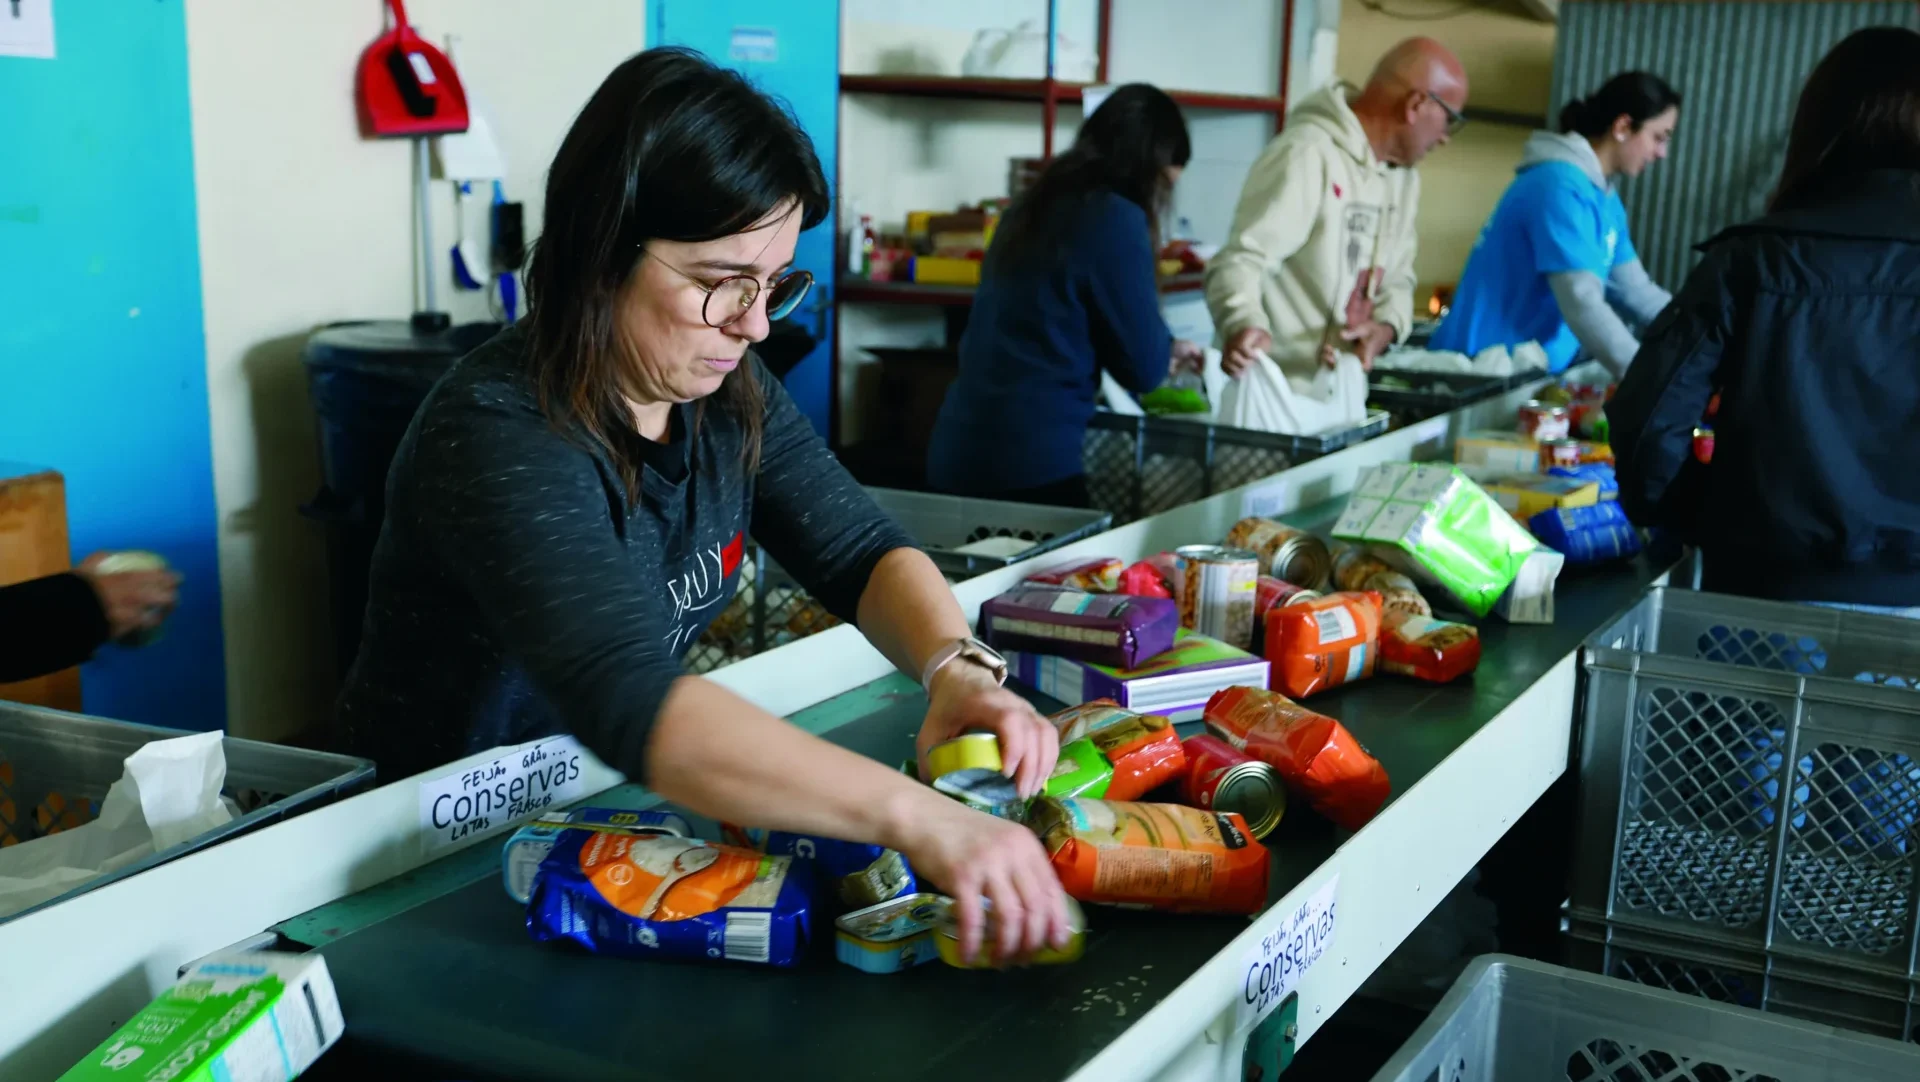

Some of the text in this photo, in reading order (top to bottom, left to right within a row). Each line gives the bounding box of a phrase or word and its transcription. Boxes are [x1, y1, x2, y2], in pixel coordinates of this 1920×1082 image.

[432, 755, 580, 829] Conservas
[451, 793, 552, 841] LATAS FRASCOS
[1245, 902, 1335, 1005] Conservas
[1256, 979, 1285, 1013] LATAS
